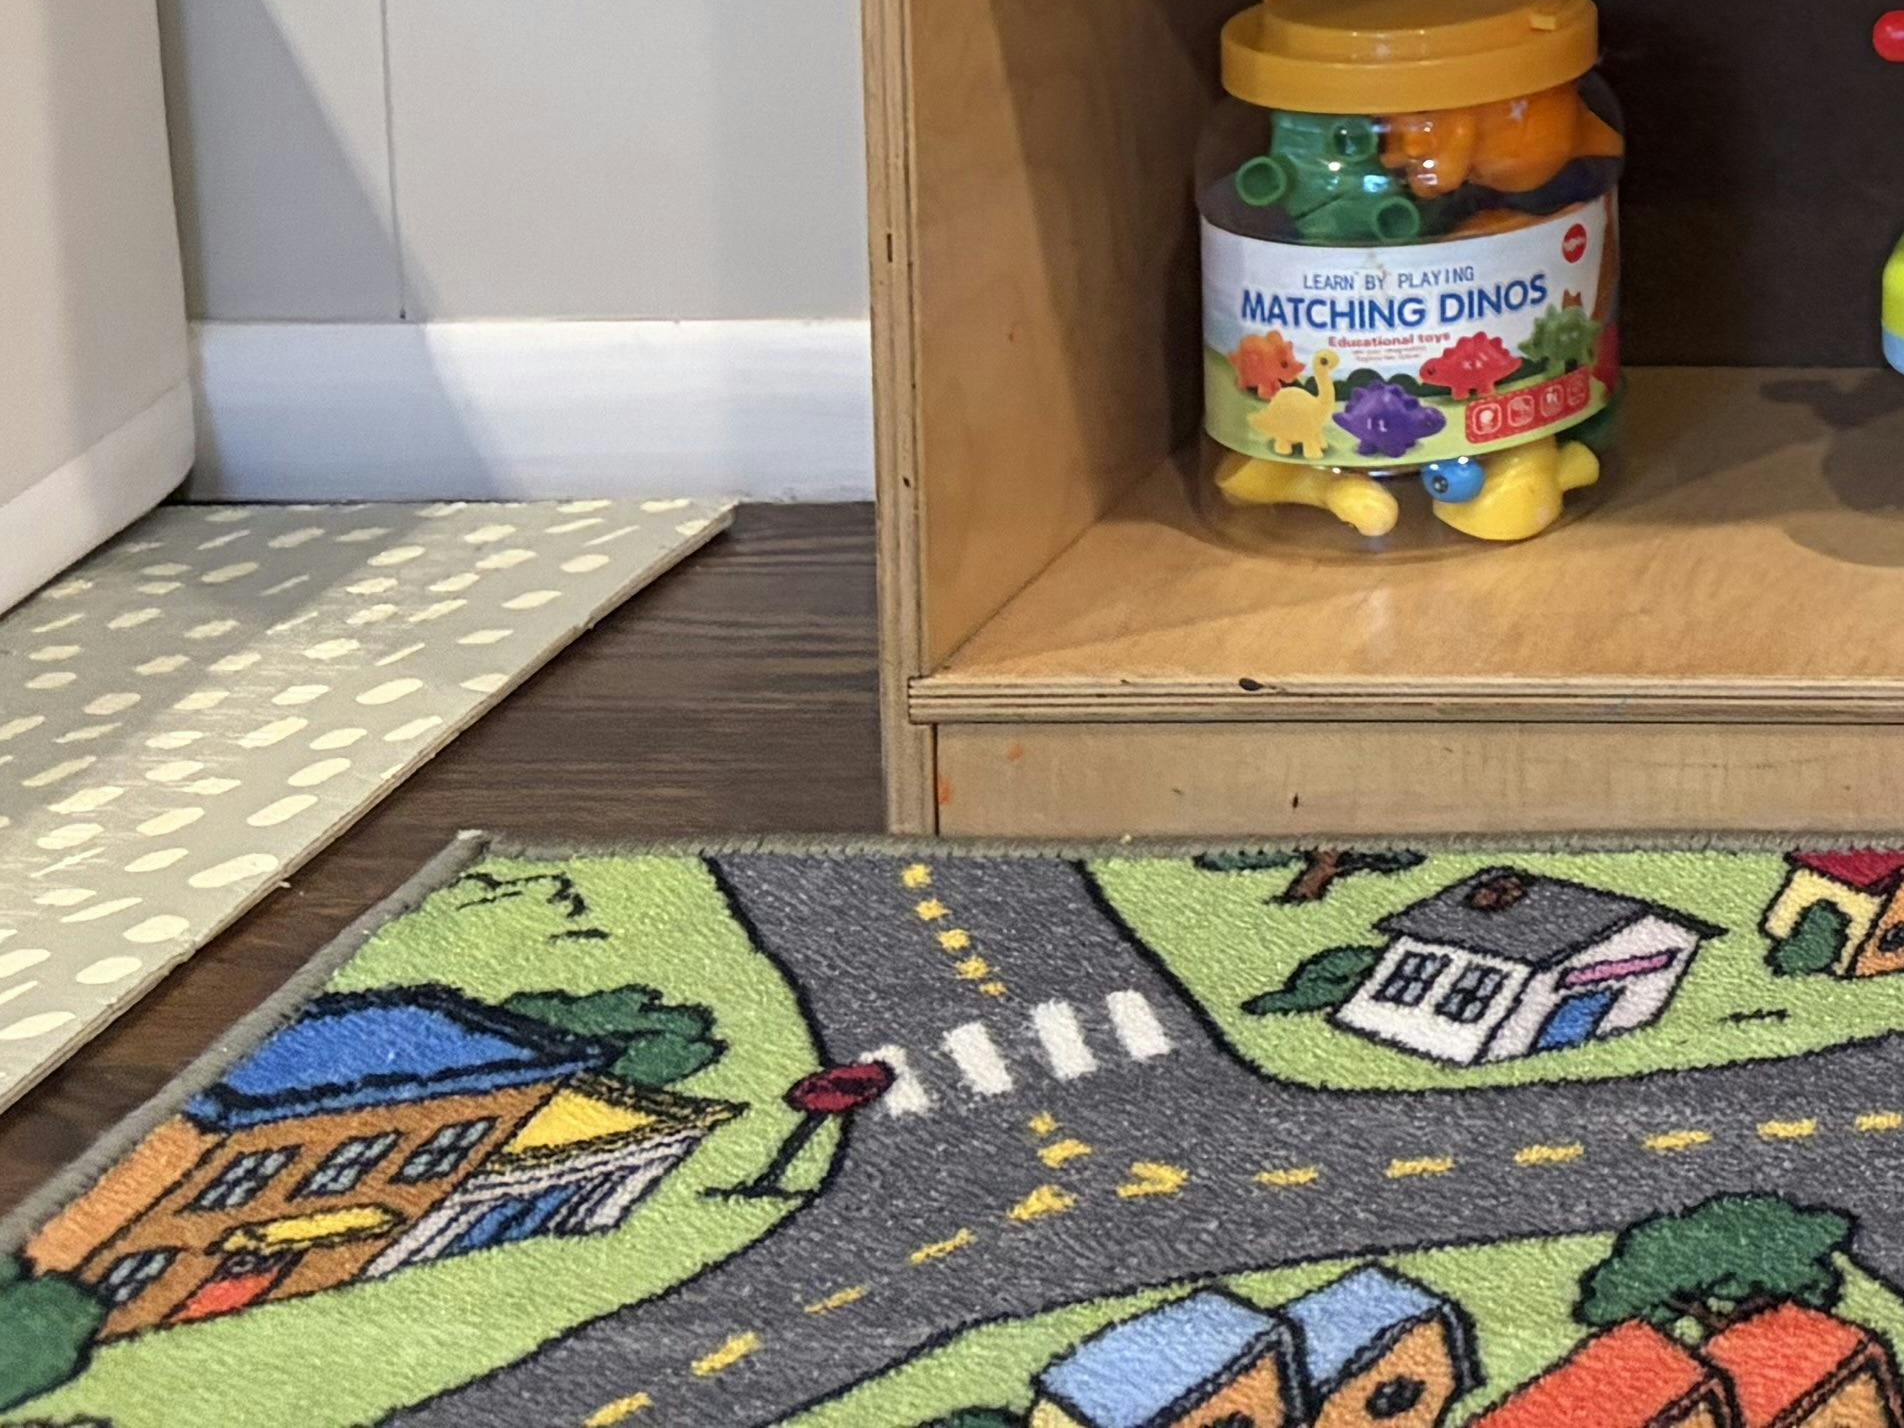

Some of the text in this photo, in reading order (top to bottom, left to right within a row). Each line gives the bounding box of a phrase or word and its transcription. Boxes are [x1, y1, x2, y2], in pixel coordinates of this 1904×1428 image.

[1303, 266, 1475, 291] LEARN BY PLAYING
[1240, 273, 1549, 330] MATCHING DINOS
[1328, 331, 1451, 349] Educational toys
